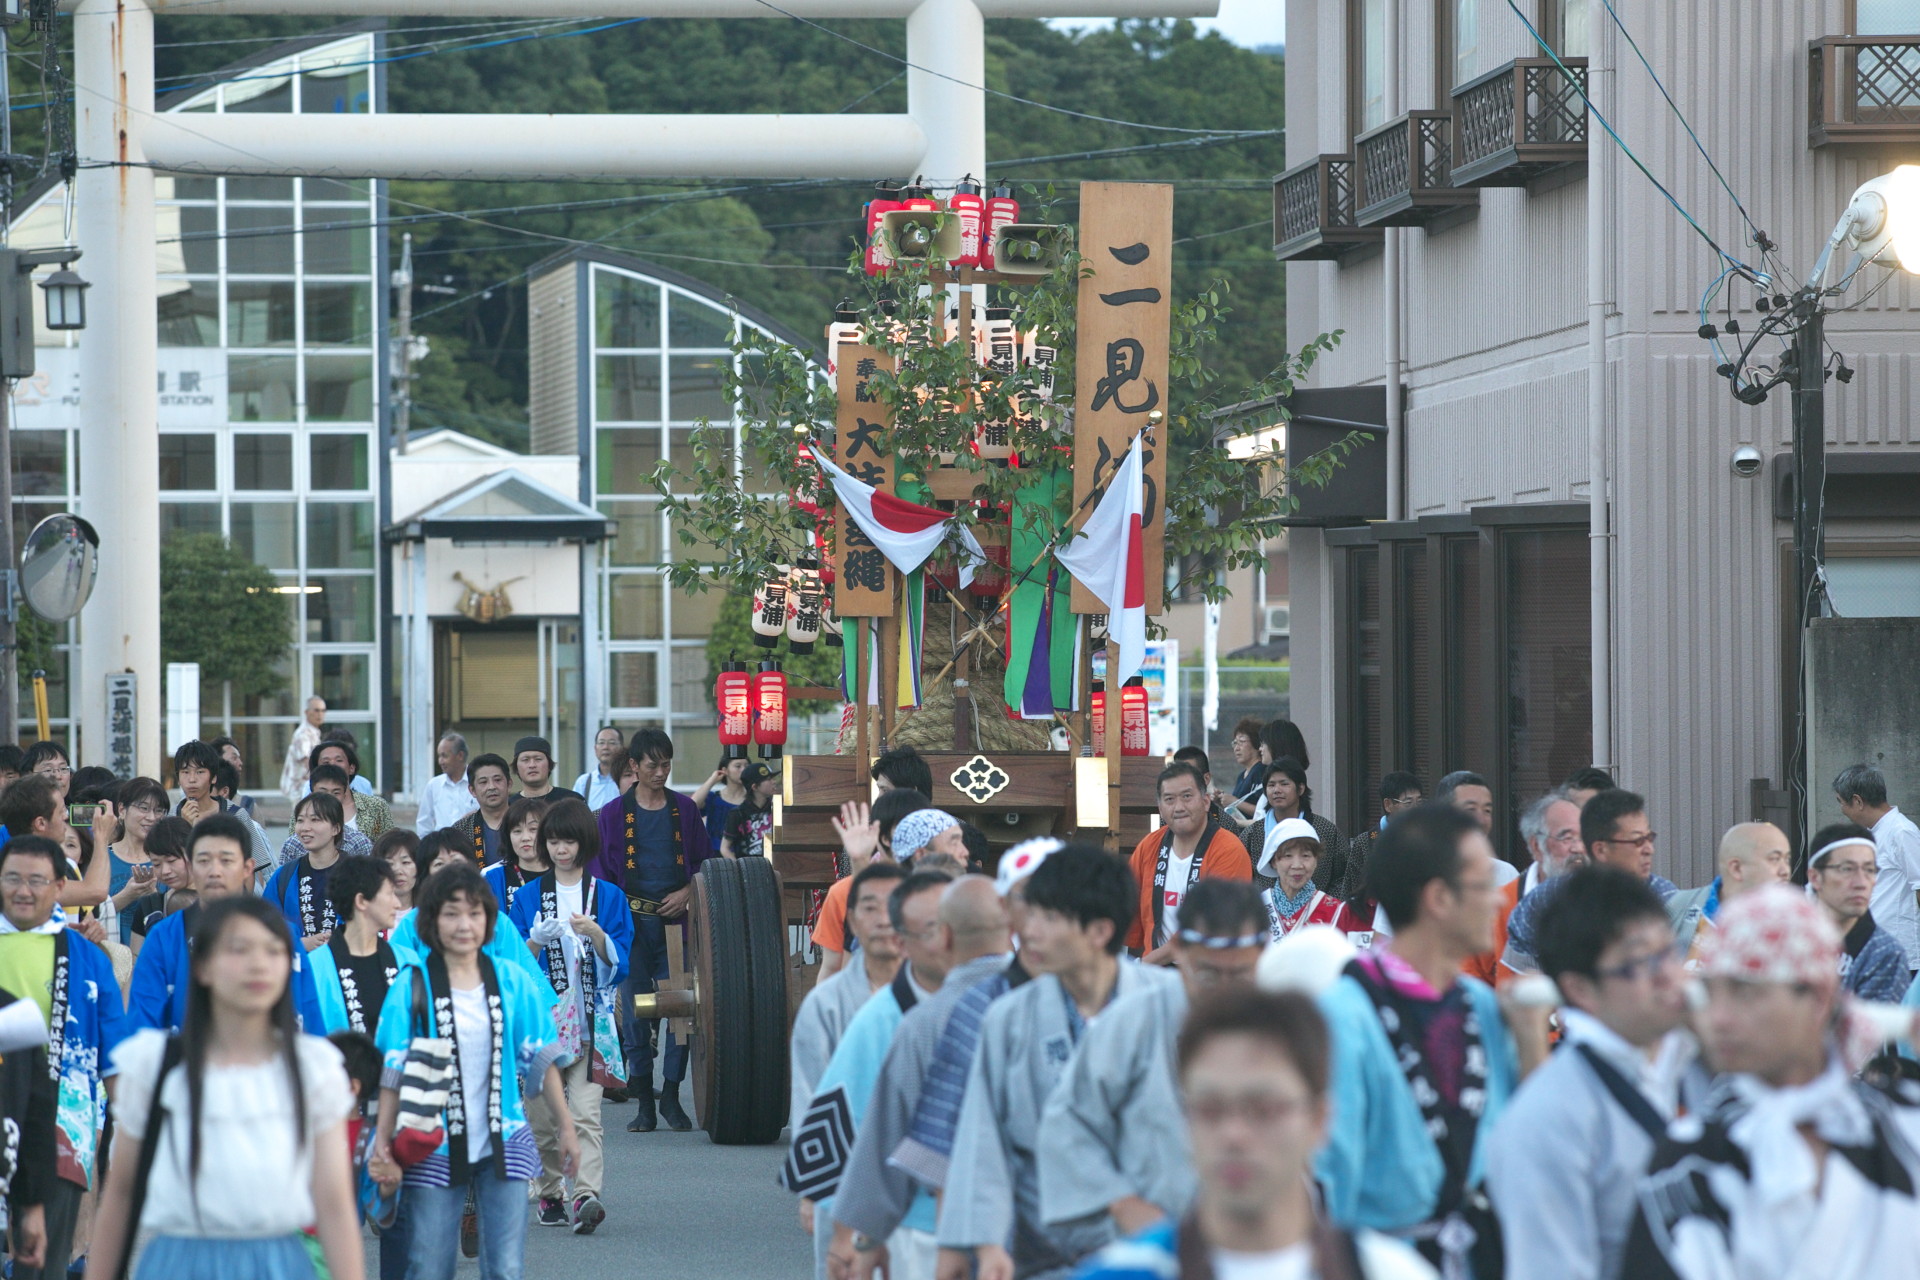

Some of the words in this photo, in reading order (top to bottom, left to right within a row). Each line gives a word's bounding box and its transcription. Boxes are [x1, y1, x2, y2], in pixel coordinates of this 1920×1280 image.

[796, 575, 821, 633] 二見浦
[111, 680, 133, 780] 二見浦観光
[724, 679, 748, 736] 二見浦
[760, 676, 784, 732] 二見浦
[1121, 693, 1147, 750] 二見浦
[1154, 846, 1169, 887] 光の街
